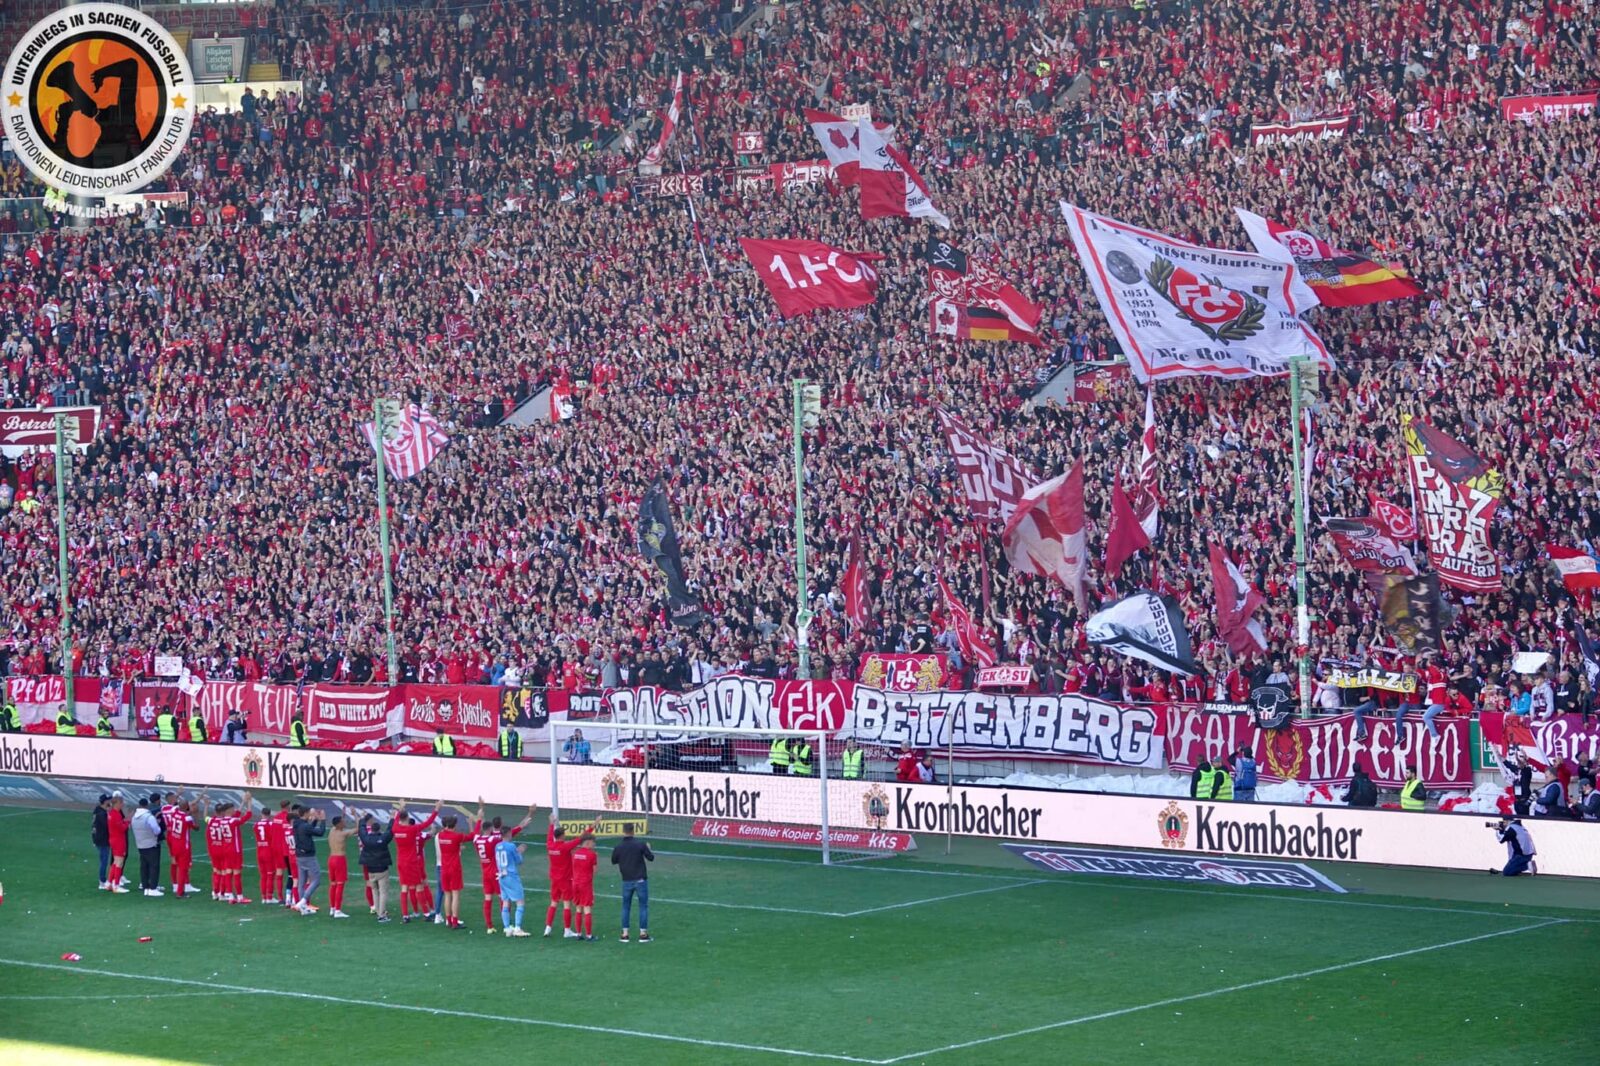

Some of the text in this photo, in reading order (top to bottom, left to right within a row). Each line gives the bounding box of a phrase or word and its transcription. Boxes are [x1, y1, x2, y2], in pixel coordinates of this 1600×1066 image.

[206, 47, 232, 56] Allgäuer
[206, 55, 232, 63] Latschen
[1136, 237, 1284, 273] Kaiserslautern
[1126, 299, 1154, 308] 1953
[3, 415, 57, 431] Betzeb
[1440, 556, 1497, 578] AUTERN
[10, 675, 63, 703] Pfalz
[1330, 668, 1402, 690] PFALZ
[319, 702, 337, 719] RED
[338, 702, 368, 722] WHITE
[410, 692, 493, 733] Devils Apostles
[609, 675, 775, 743] BASTION
[854, 684, 1157, 766] BETZENBERG
[268, 750, 378, 796] Krombacher
[630, 770, 761, 820] Krombacher
[895, 786, 1043, 838] Krombacher
[738, 824, 780, 838] Kemmler
[781, 827, 814, 843] Kopier
[814, 830, 860, 844] Ssteme
[1195, 804, 1364, 860] Krombacher
